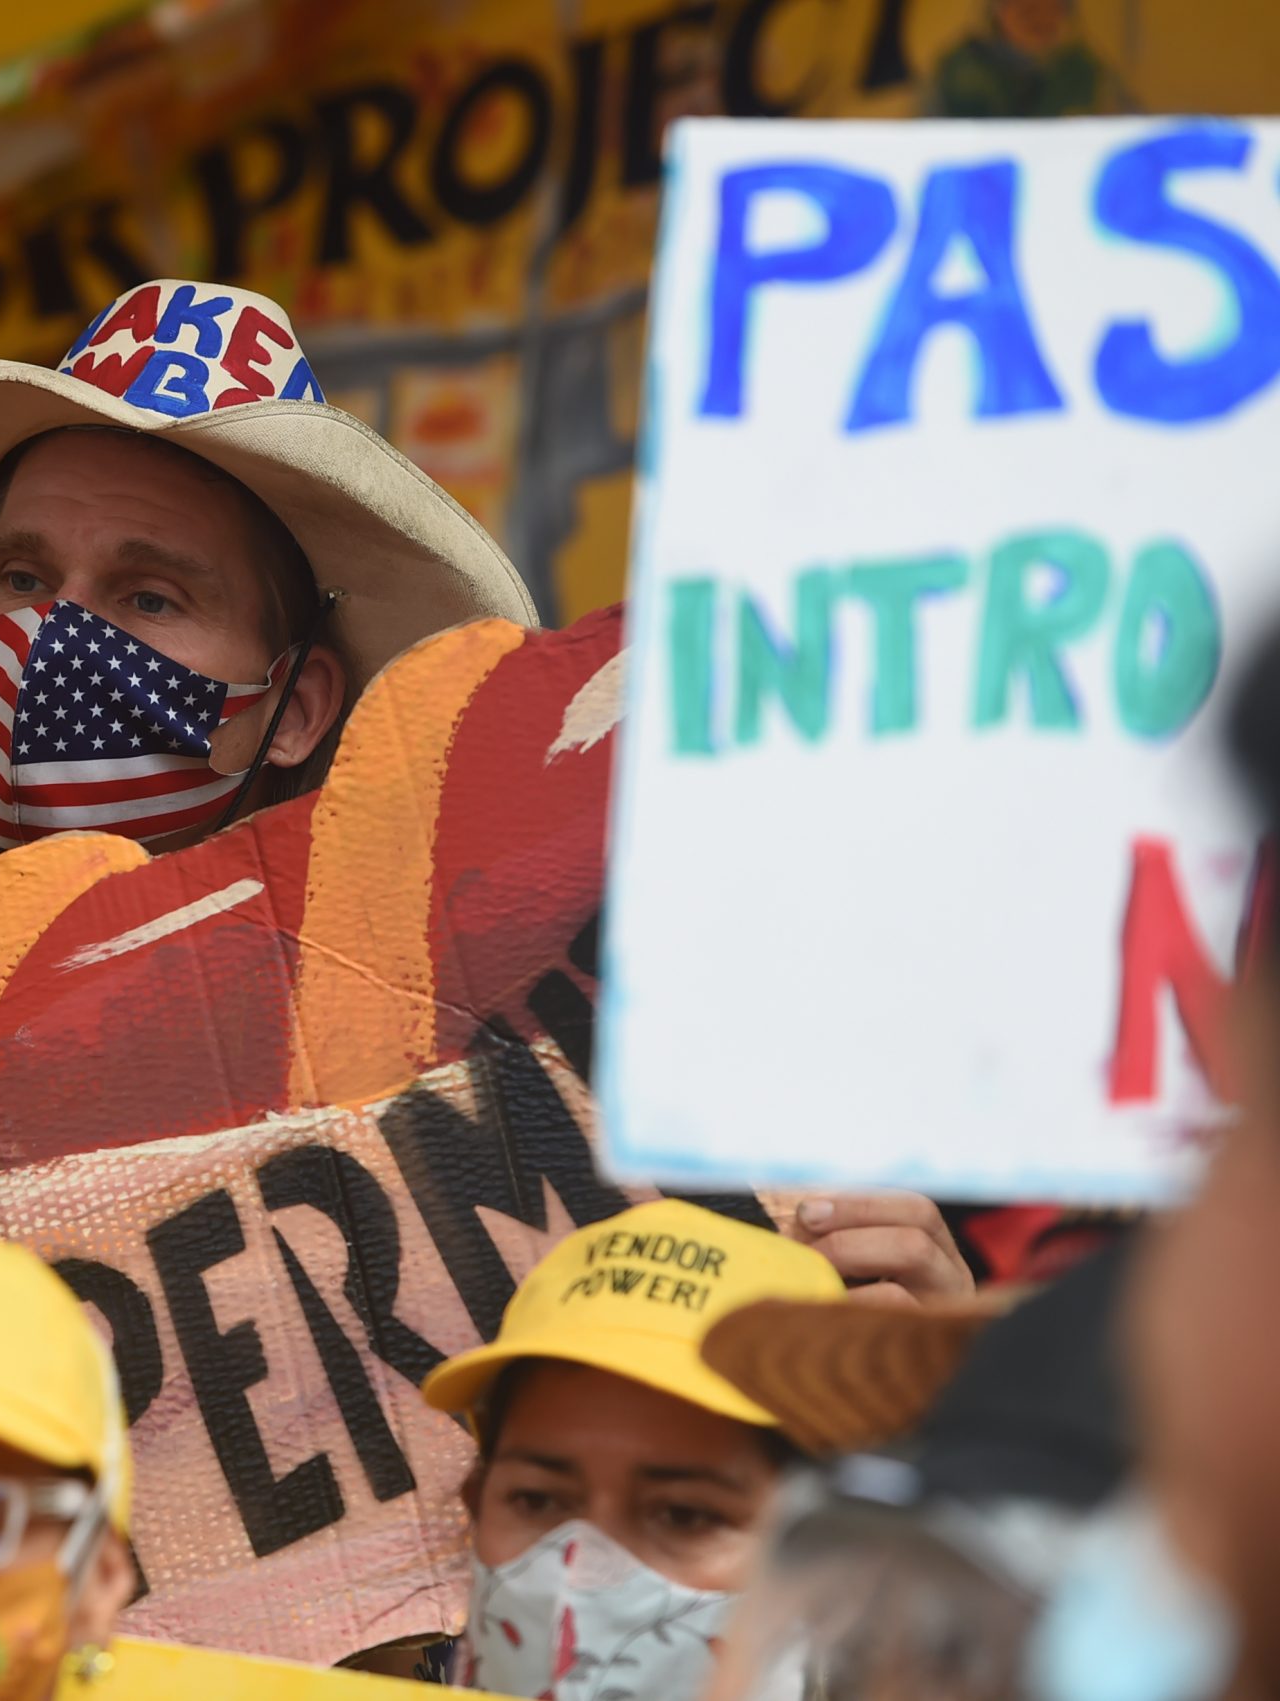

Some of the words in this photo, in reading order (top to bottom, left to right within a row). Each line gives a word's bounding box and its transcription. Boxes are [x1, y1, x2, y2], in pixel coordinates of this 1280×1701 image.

[694, 118, 1280, 435] PAS
[67, 285, 325, 404] AKE
[668, 540, 1222, 758] INTRO
[562, 1268, 711, 1312] POWER!
[586, 1231, 727, 1278] VENDOR
